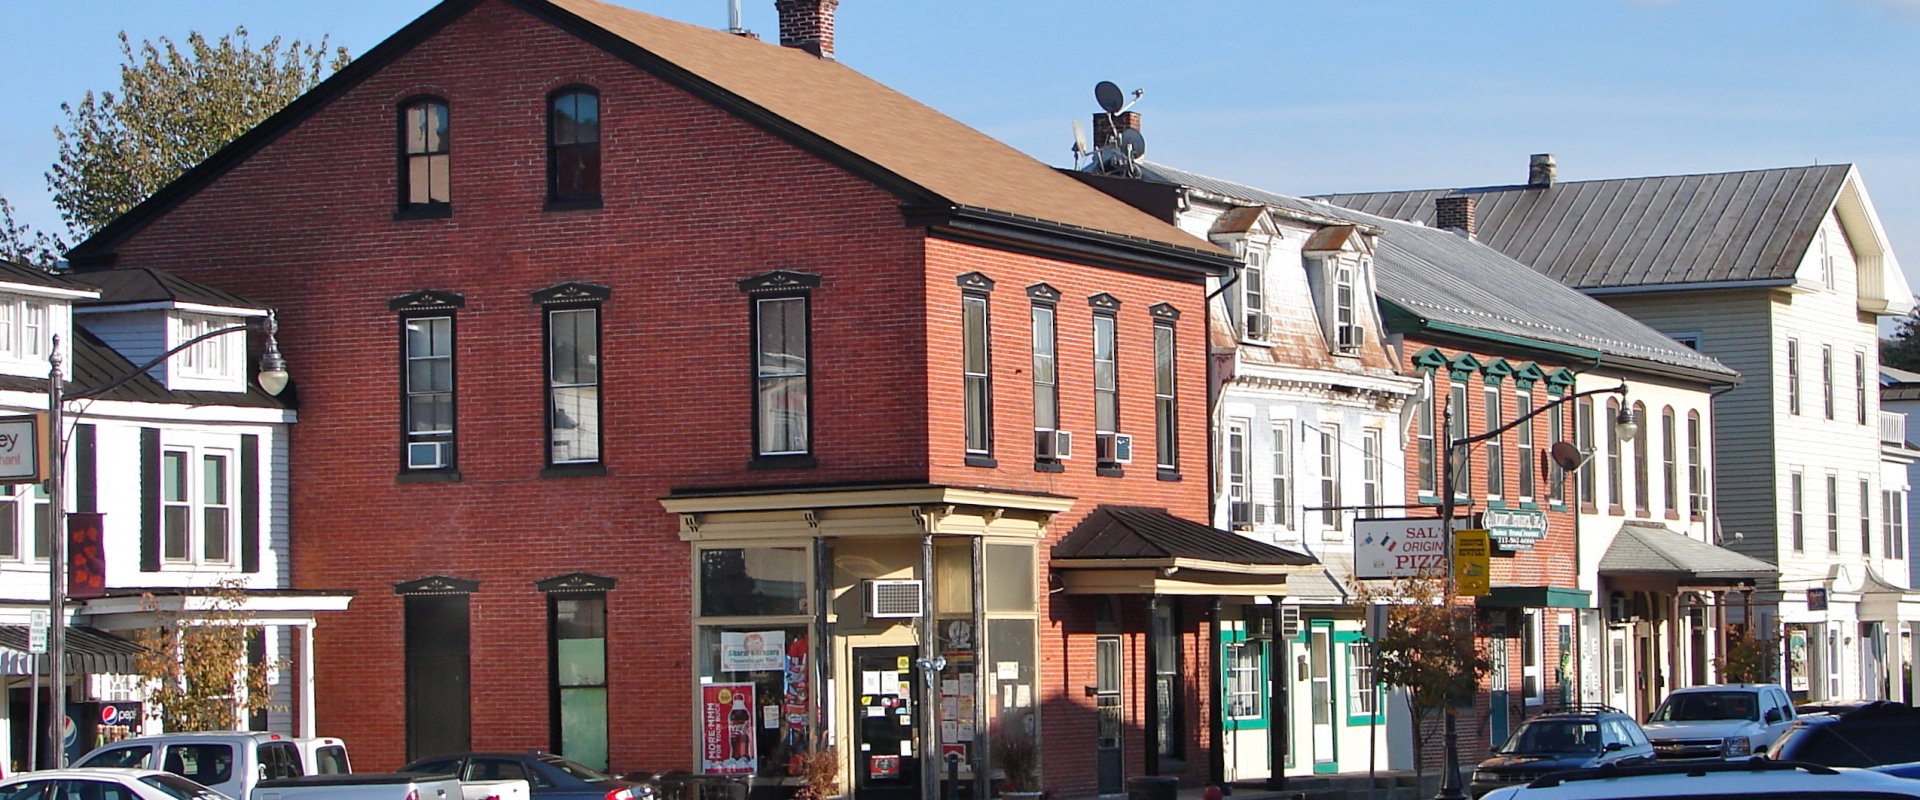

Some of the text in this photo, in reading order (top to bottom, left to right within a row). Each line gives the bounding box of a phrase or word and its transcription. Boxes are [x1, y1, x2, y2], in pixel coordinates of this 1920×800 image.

[0, 433, 18, 452] ey
[1402, 541, 1443, 553] ORIGIN
[1395, 554, 1444, 570] PIZZ
